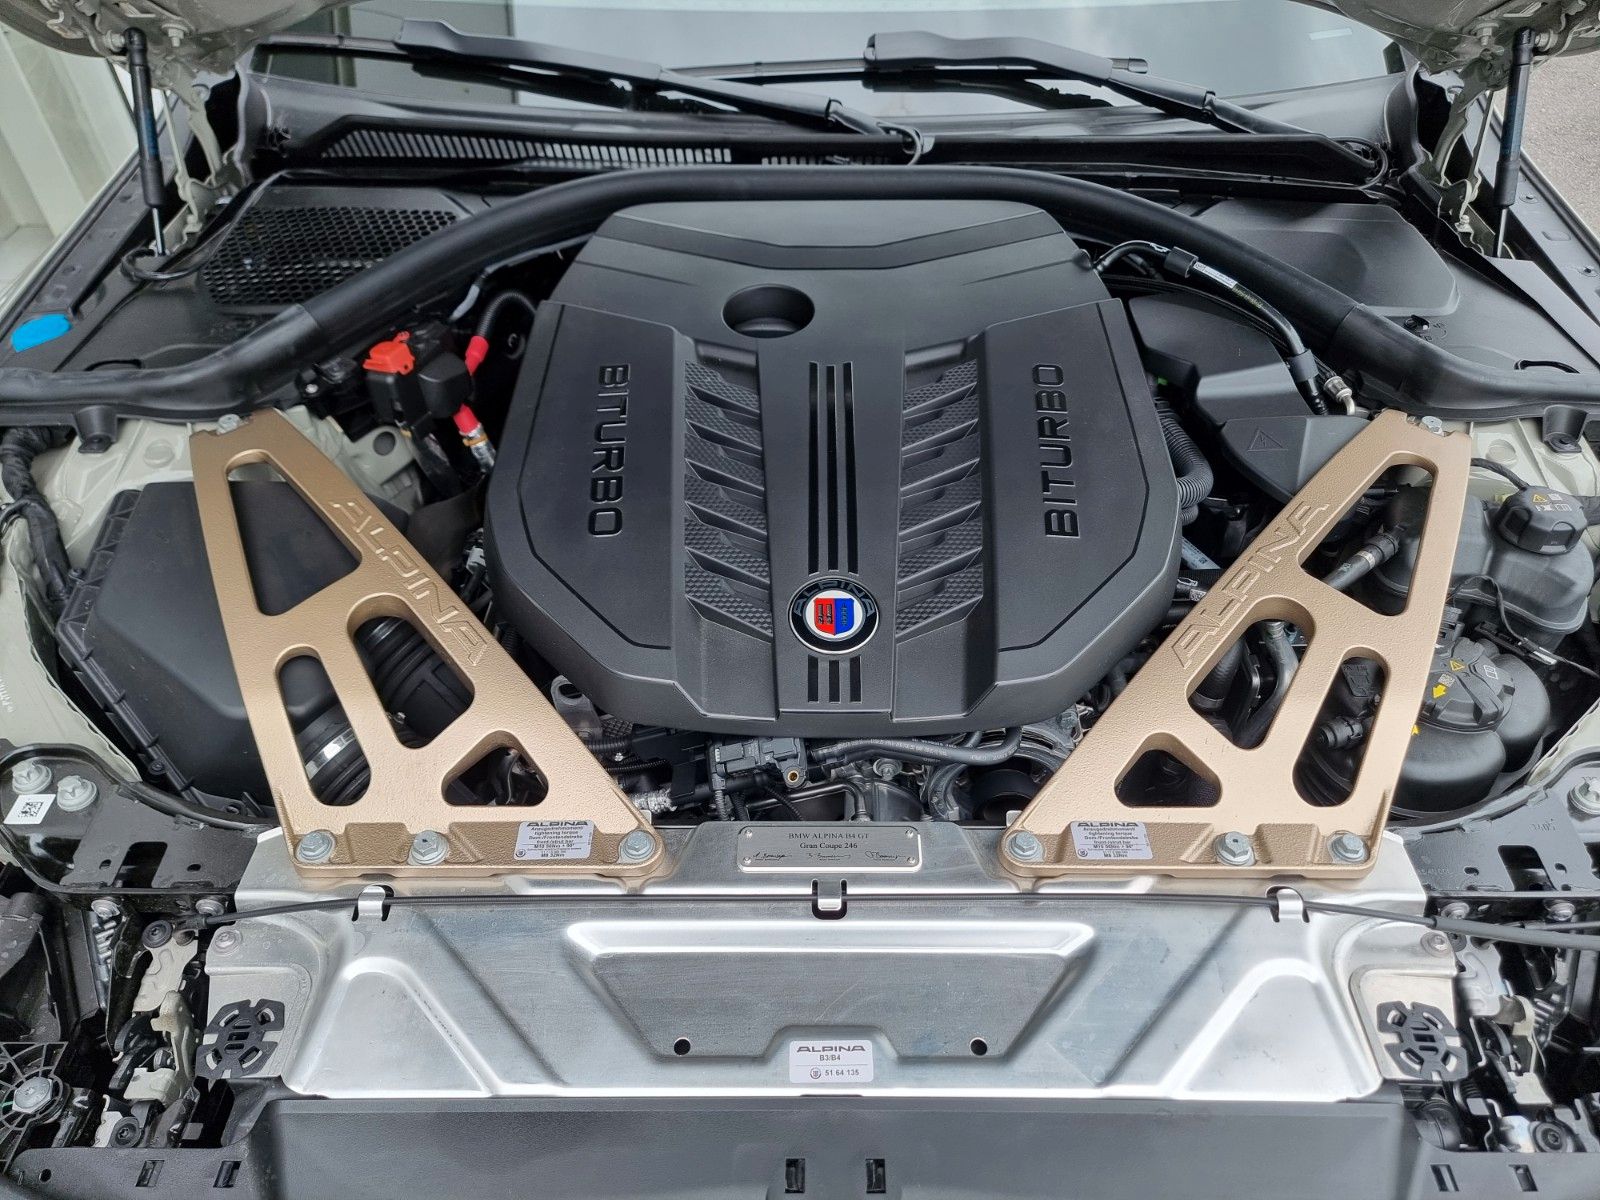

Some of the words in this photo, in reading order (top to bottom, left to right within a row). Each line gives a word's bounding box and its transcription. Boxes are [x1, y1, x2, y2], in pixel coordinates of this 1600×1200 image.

[588, 363, 630, 537] BITURBO
[1032, 363, 1080, 538] BITURBO
[331, 499, 487, 667] ALPINA
[793, 580, 876, 617] ALPINA
[1171, 501, 1330, 669] ALPINA
[820, 842, 842, 850] Coupe
[797, 1045, 866, 1053] ALPINA
